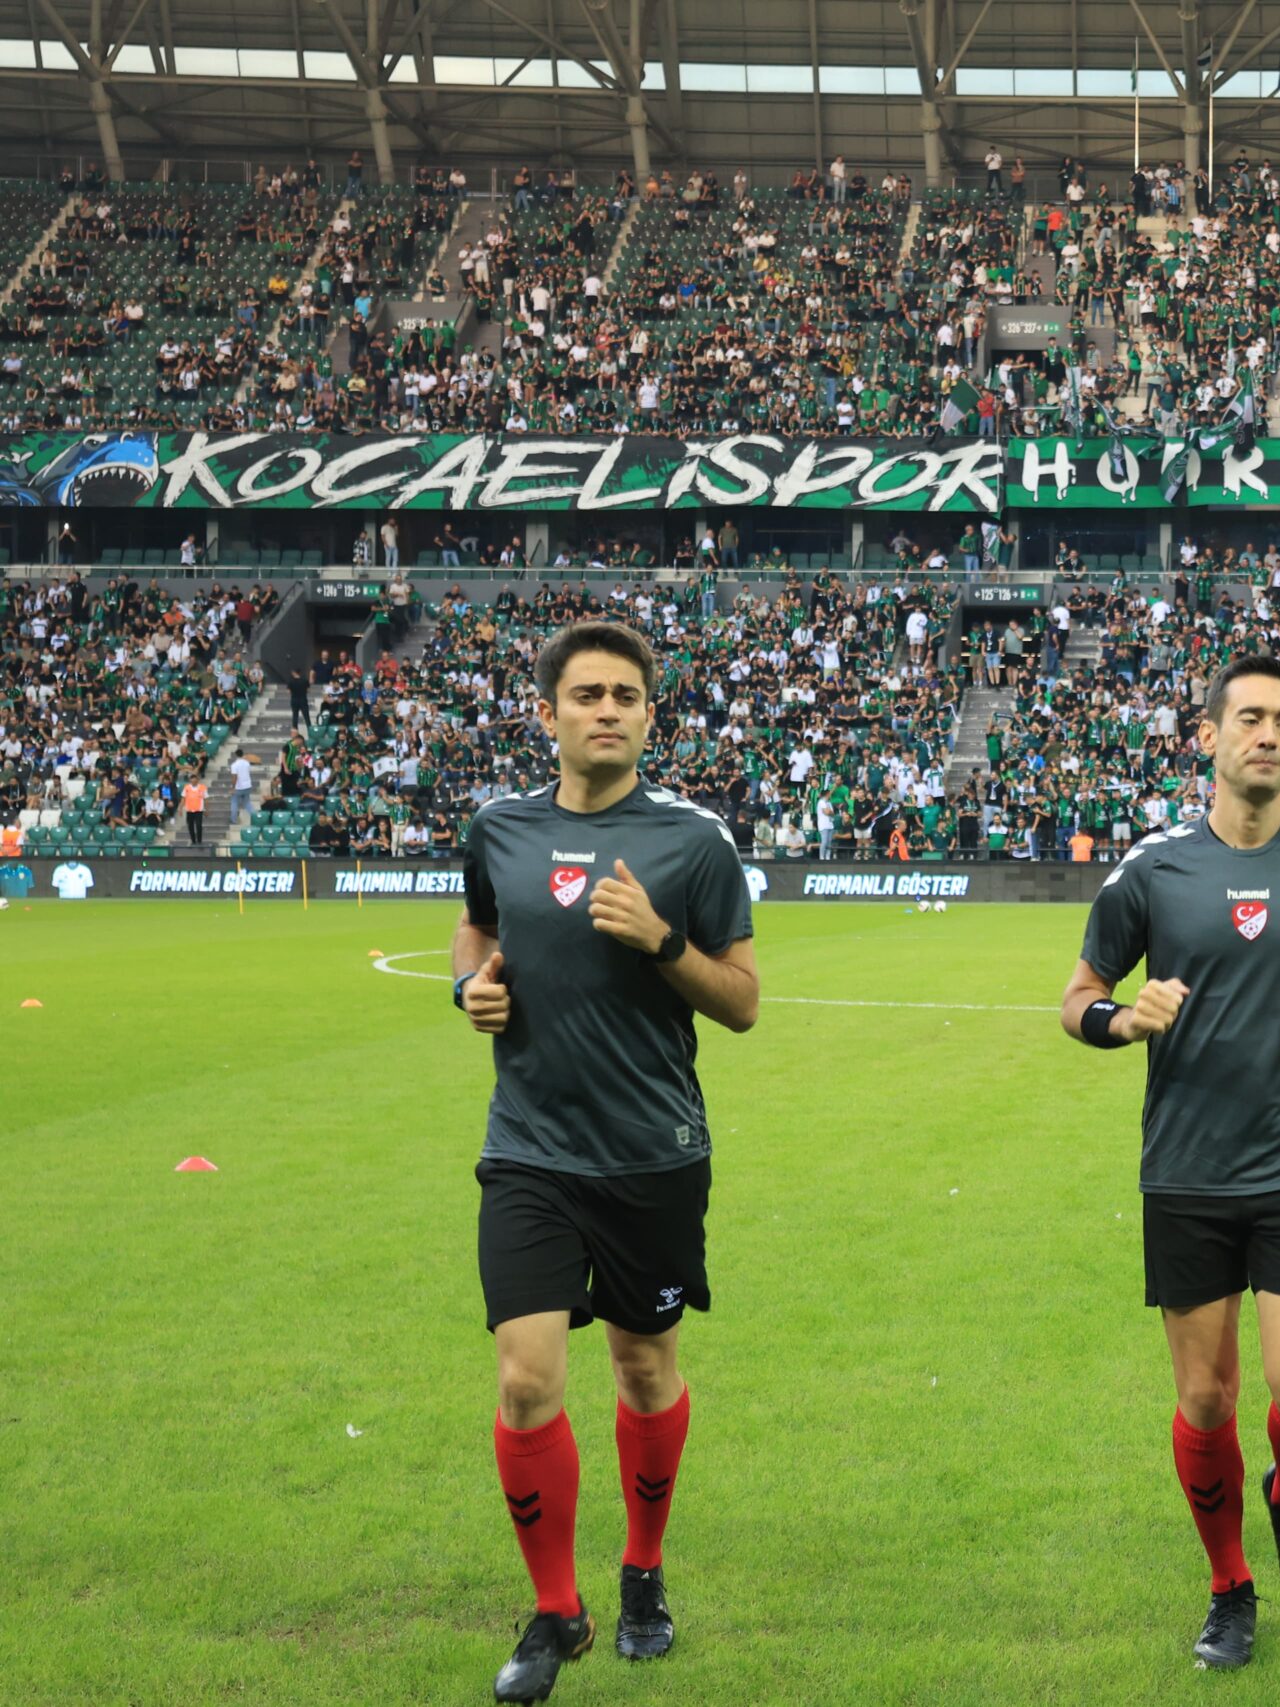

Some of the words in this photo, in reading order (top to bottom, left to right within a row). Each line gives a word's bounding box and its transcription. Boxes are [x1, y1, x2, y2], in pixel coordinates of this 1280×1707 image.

[981, 588, 994, 601] 125
[998, 588, 1012, 601] 126
[552, 849, 596, 863] hummel
[130, 870, 222, 892] FORMANLA
[335, 871, 413, 892] TAKIMINA
[804, 873, 895, 895] FORMANLA
[896, 871, 969, 896] GÖSTER!
[1227, 888, 1270, 900] hummel
